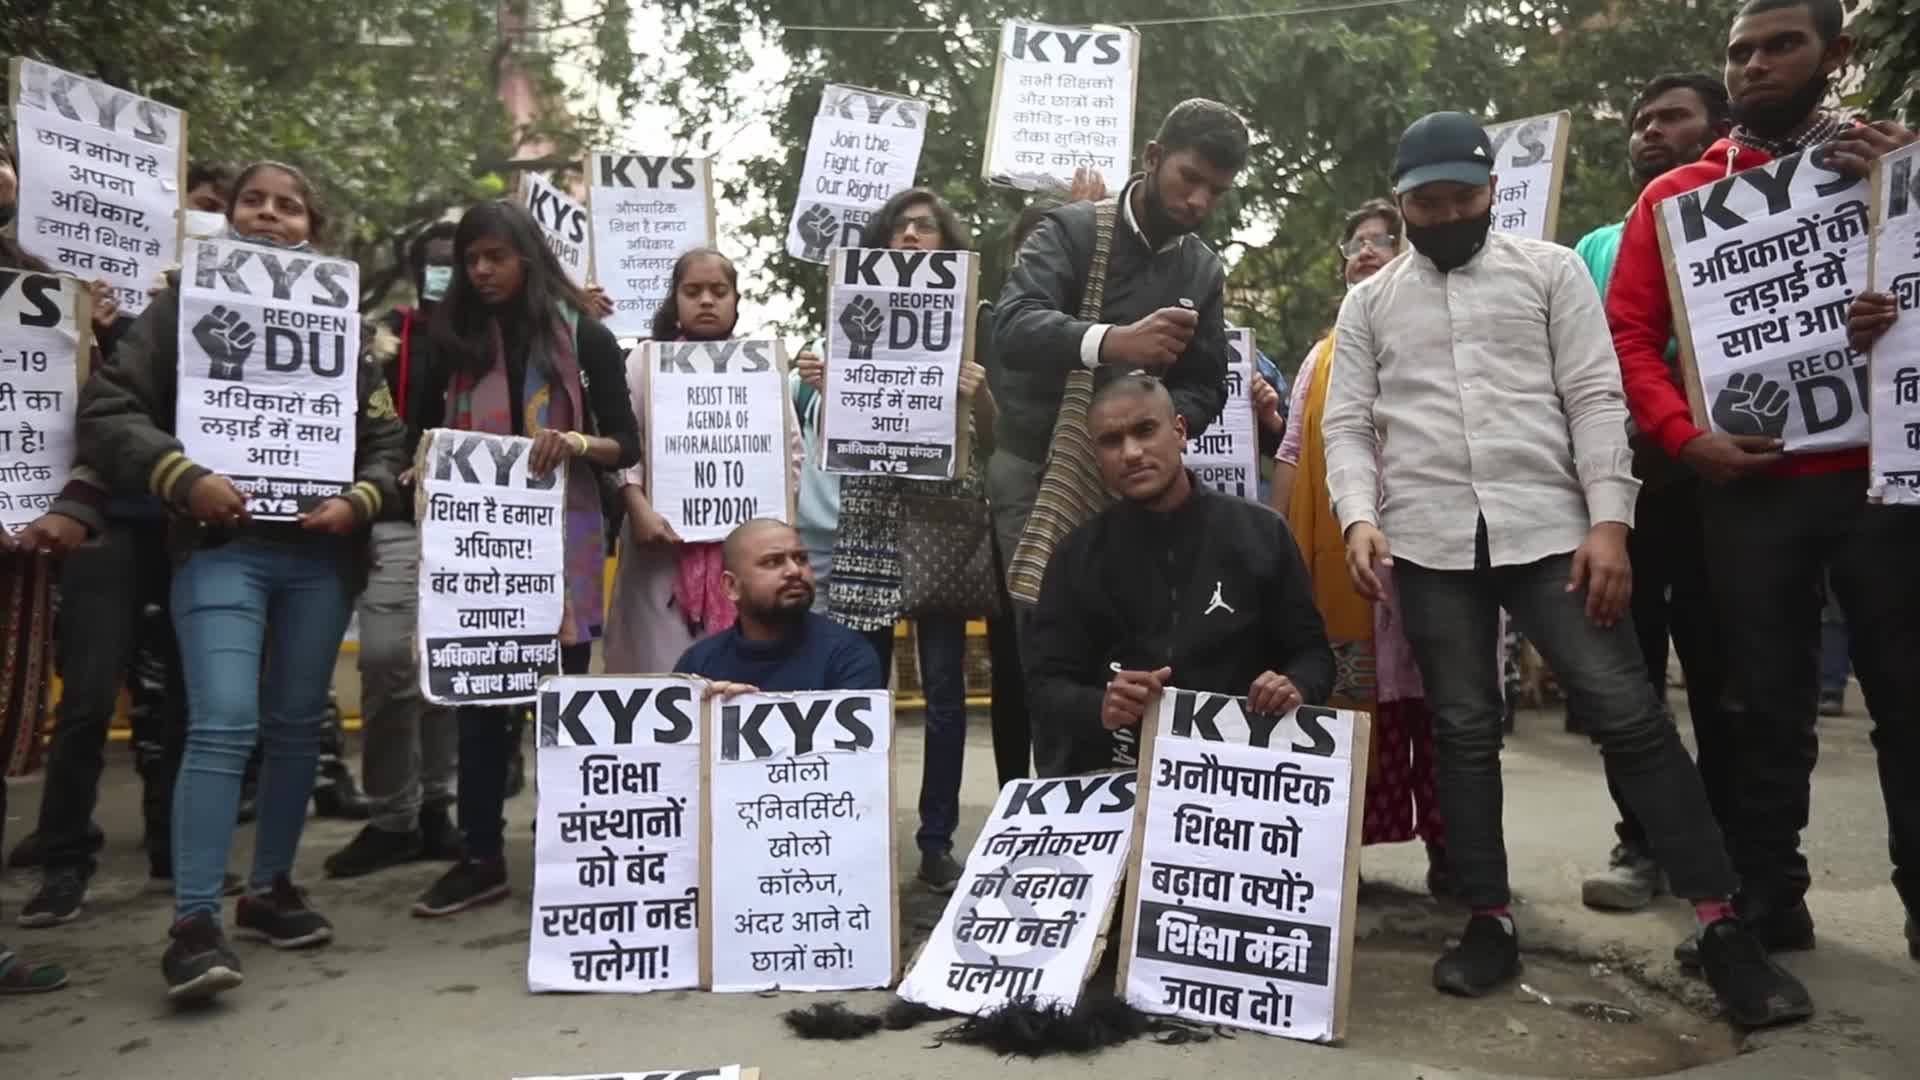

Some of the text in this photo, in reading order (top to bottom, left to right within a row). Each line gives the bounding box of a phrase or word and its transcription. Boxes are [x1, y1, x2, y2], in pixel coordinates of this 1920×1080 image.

[1012, 27, 1121, 64] KYS
[22, 65, 168, 145] KYS
[825, 94, 920, 128] KYS
[1092, 95, 1114, 108] को
[1095, 116, 1117, 128] का
[37, 129, 159, 178] छात्र मांग रहे
[830, 130, 890, 152] Join the
[601, 156, 696, 189] KYS
[824, 152, 861, 175] Fight
[1015, 149, 1115, 168] कर कॉलेज
[68, 164, 134, 196] अपना
[817, 176, 890, 201] Our Right!
[1677, 144, 1863, 243] KYS
[51, 190, 149, 232] अधिकार,
[530, 183, 586, 243] KYS
[843, 209, 872, 224] REO
[1821, 200, 1870, 243] की
[35, 215, 161, 256] हमारी शिक्षा से
[1689, 214, 1822, 287] अधिकारों
[58, 247, 138, 278] मत करो
[195, 244, 350, 308] KYS
[845, 251, 957, 289] KYS
[1724, 248, 1848, 315] लड़ाई में
[889, 292, 954, 309] REOPEN
[263, 308, 347, 333] REOPEN
[889, 310, 951, 351] DU
[1717, 316, 1791, 357] साथ
[265, 326, 344, 378] DU
[660, 341, 770, 373] KYS
[844, 364, 943, 386] अधिकारों की
[22, 390, 63, 412] का
[204, 387, 306, 414] अधिकारों
[310, 392, 342, 417] की
[687, 386, 748, 405] RESIST THE
[841, 389, 942, 412] लड़ाई में साथ
[200, 415, 341, 443] लड़ाई में साथ
[687, 411, 749, 430] AGENDA OF
[872, 413, 910, 432] आएं!
[19, 421, 44, 454] है!
[665, 434, 772, 454] INFORMALISATION!
[1193, 428, 1232, 454] आएं!
[247, 444, 300, 467] आएं!
[870, 460, 908, 472] KYS
[694, 461, 744, 488] NO TO
[246, 499, 298, 514] KYS
[430, 493, 554, 527] शिक्षा है हमारा
[682, 497, 757, 526] NEP2020!
[454, 532, 533, 560] अधिकार!
[430, 567, 555, 597] बंद करो इसका
[458, 607, 525, 630] व्यापार!
[431, 640, 557, 667] अधिकारों की लड़ाई
[451, 671, 470, 695] में
[469, 674, 504, 694] साथ
[540, 686, 694, 746] KYS
[721, 697, 874, 761] KYS
[1172, 693, 1338, 757] KYS
[579, 754, 661, 796] शिक्षा
[766, 756, 830, 784] खोलो
[1157, 753, 1334, 806] अनौपचारिक
[1003, 772, 1137, 819] KYS
[558, 796, 687, 844] संस्थानों
[1173, 804, 1303, 858] शिक्षा को
[768, 830, 831, 858] खोलो
[576, 845, 668, 888] को बंद
[758, 868, 843, 897] कॉलेज,
[970, 867, 1093, 907] को बढ़ावा
[1151, 862, 1314, 913] बढ़ावा क्यों?
[539, 900, 638, 937] रखना
[734, 904, 871, 934] अंदर आने दो
[956, 908, 1086, 948] देना नहीं
[751, 943, 853, 972] छात्रों को!
[1156, 911, 1312, 974] शिक्षा मंत्री
[570, 938, 670, 982] चलेगा!
[947, 955, 1043, 1000] चलेगा!
[1160, 976, 1293, 1028] जवाब दो!
